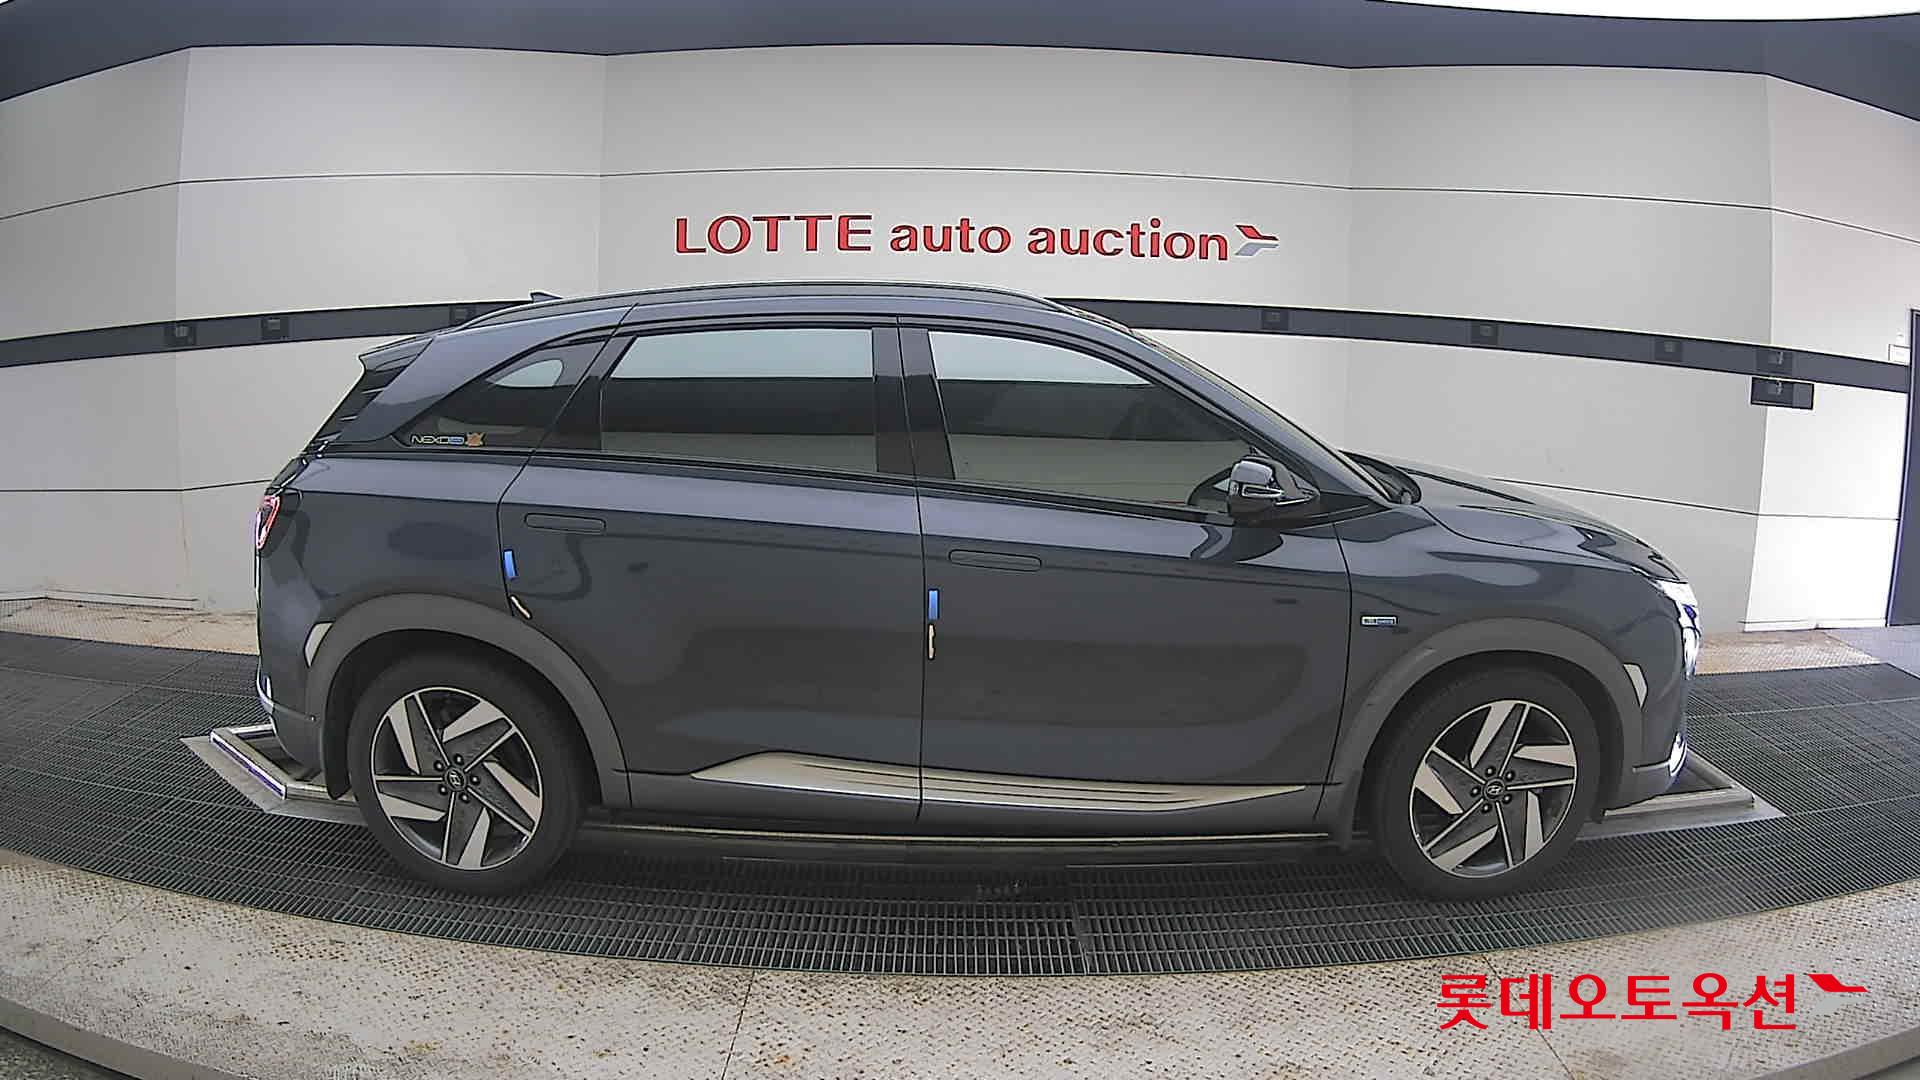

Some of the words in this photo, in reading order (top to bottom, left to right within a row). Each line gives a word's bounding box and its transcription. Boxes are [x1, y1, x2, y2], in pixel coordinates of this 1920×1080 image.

[675, 214, 873, 254] LOTTE
[890, 217, 1012, 254] auto
[1026, 218, 1229, 261] auction
